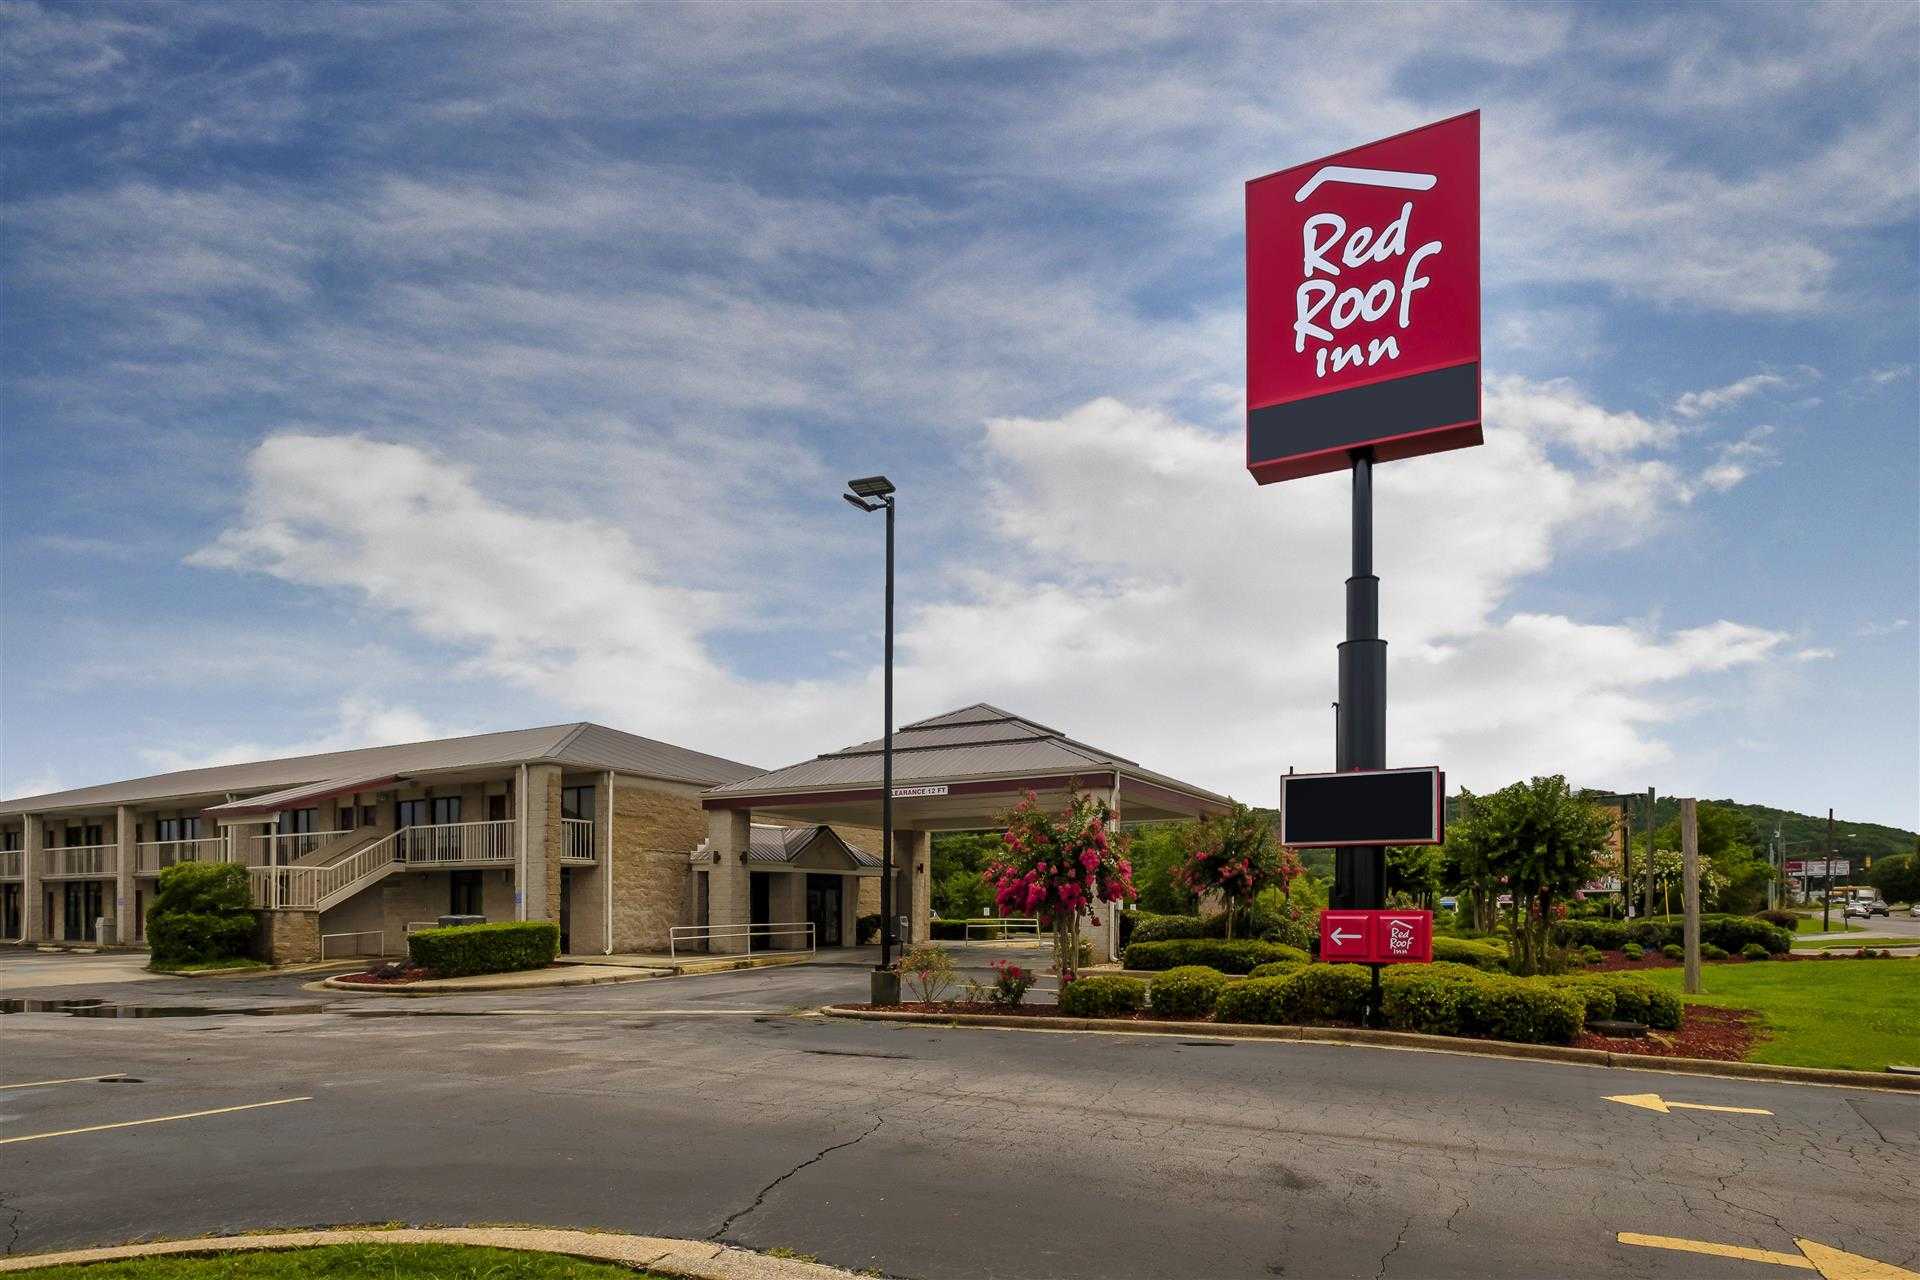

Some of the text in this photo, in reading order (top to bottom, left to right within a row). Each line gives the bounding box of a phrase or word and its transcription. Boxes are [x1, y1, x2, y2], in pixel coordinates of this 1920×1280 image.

[1303, 202, 1413, 278] Red
[1294, 241, 1443, 354] Roof
[1390, 937, 1414, 950] Roof
[1392, 928, 1409, 939] Red
